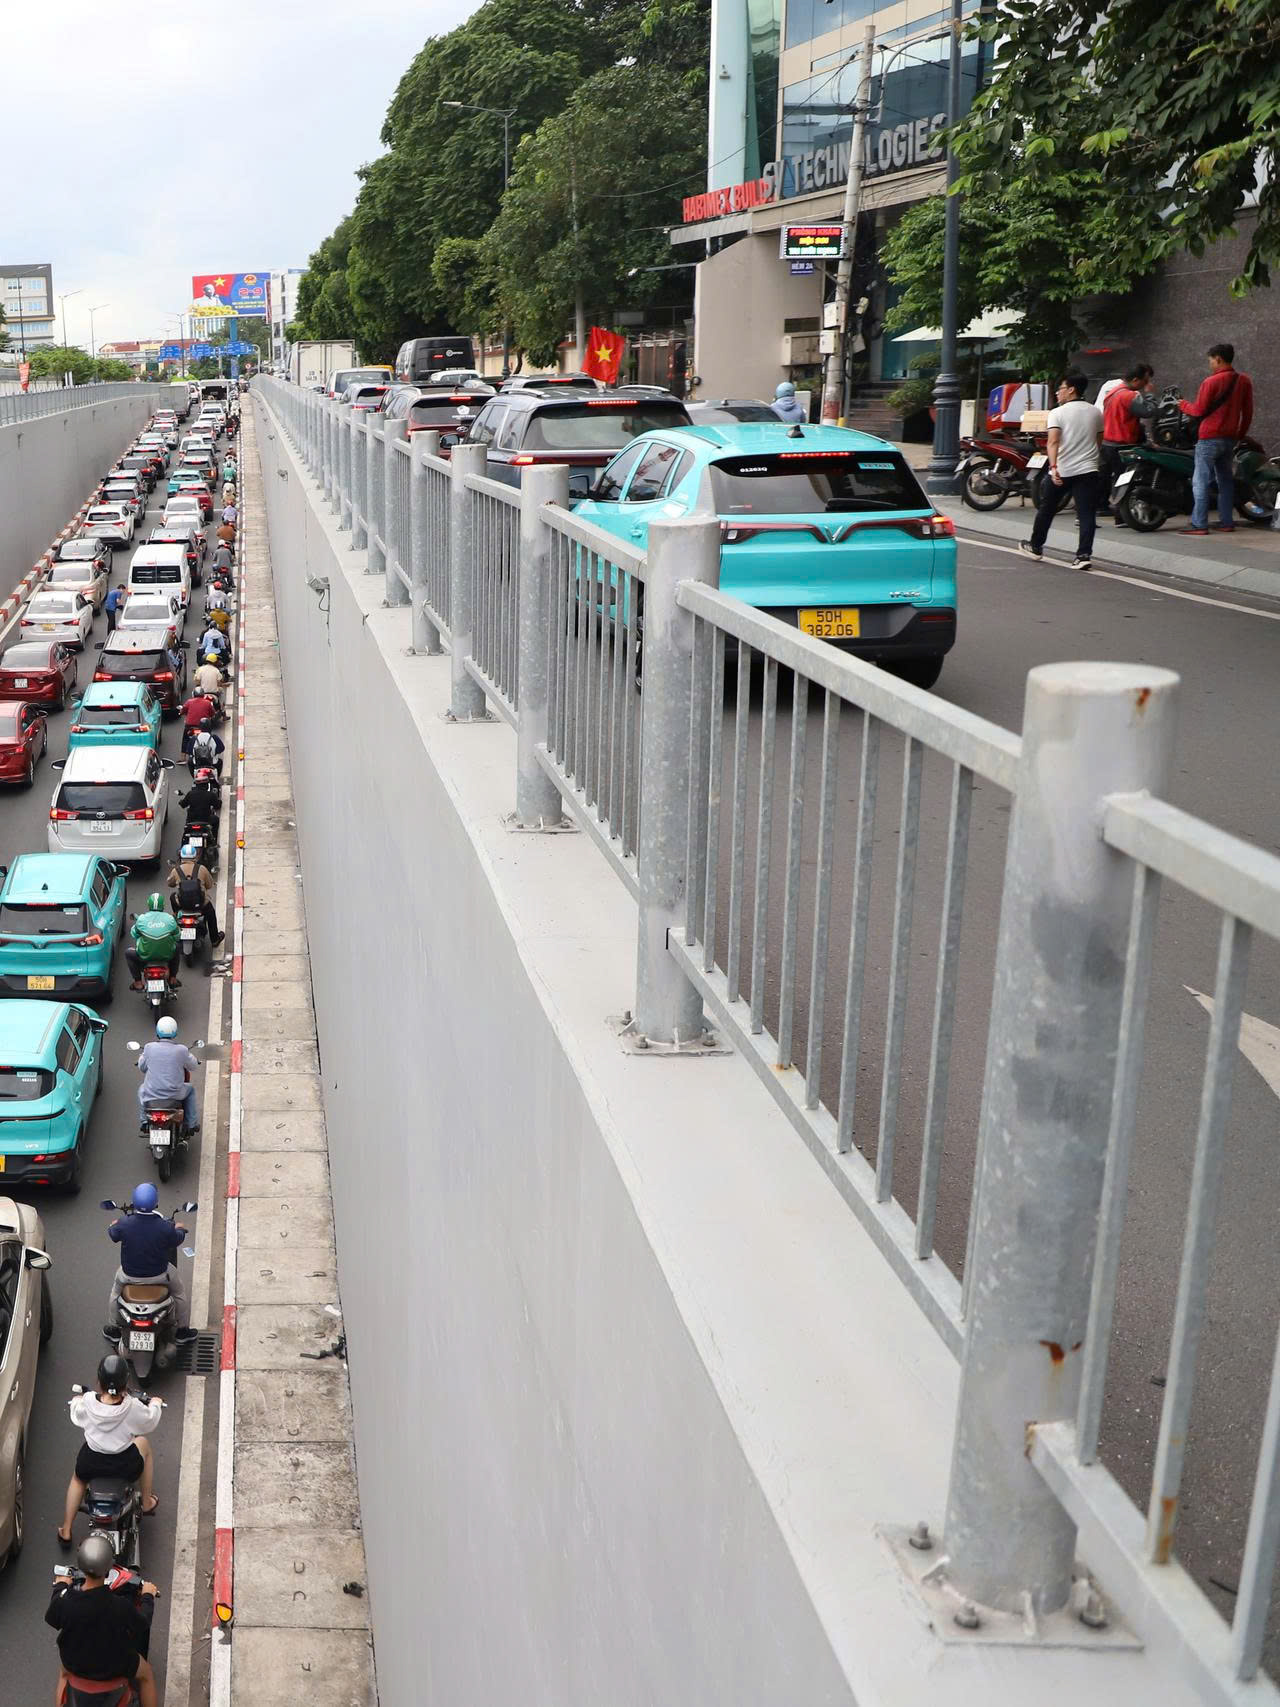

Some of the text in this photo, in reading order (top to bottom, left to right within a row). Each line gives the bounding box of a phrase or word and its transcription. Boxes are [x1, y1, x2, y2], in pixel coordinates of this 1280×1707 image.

[791, 113, 947, 193] TECHNLOGIES
[816, 610, 842, 622] 50H
[807, 624, 853, 636] 382.06
[147, 921, 166, 929] Grab
